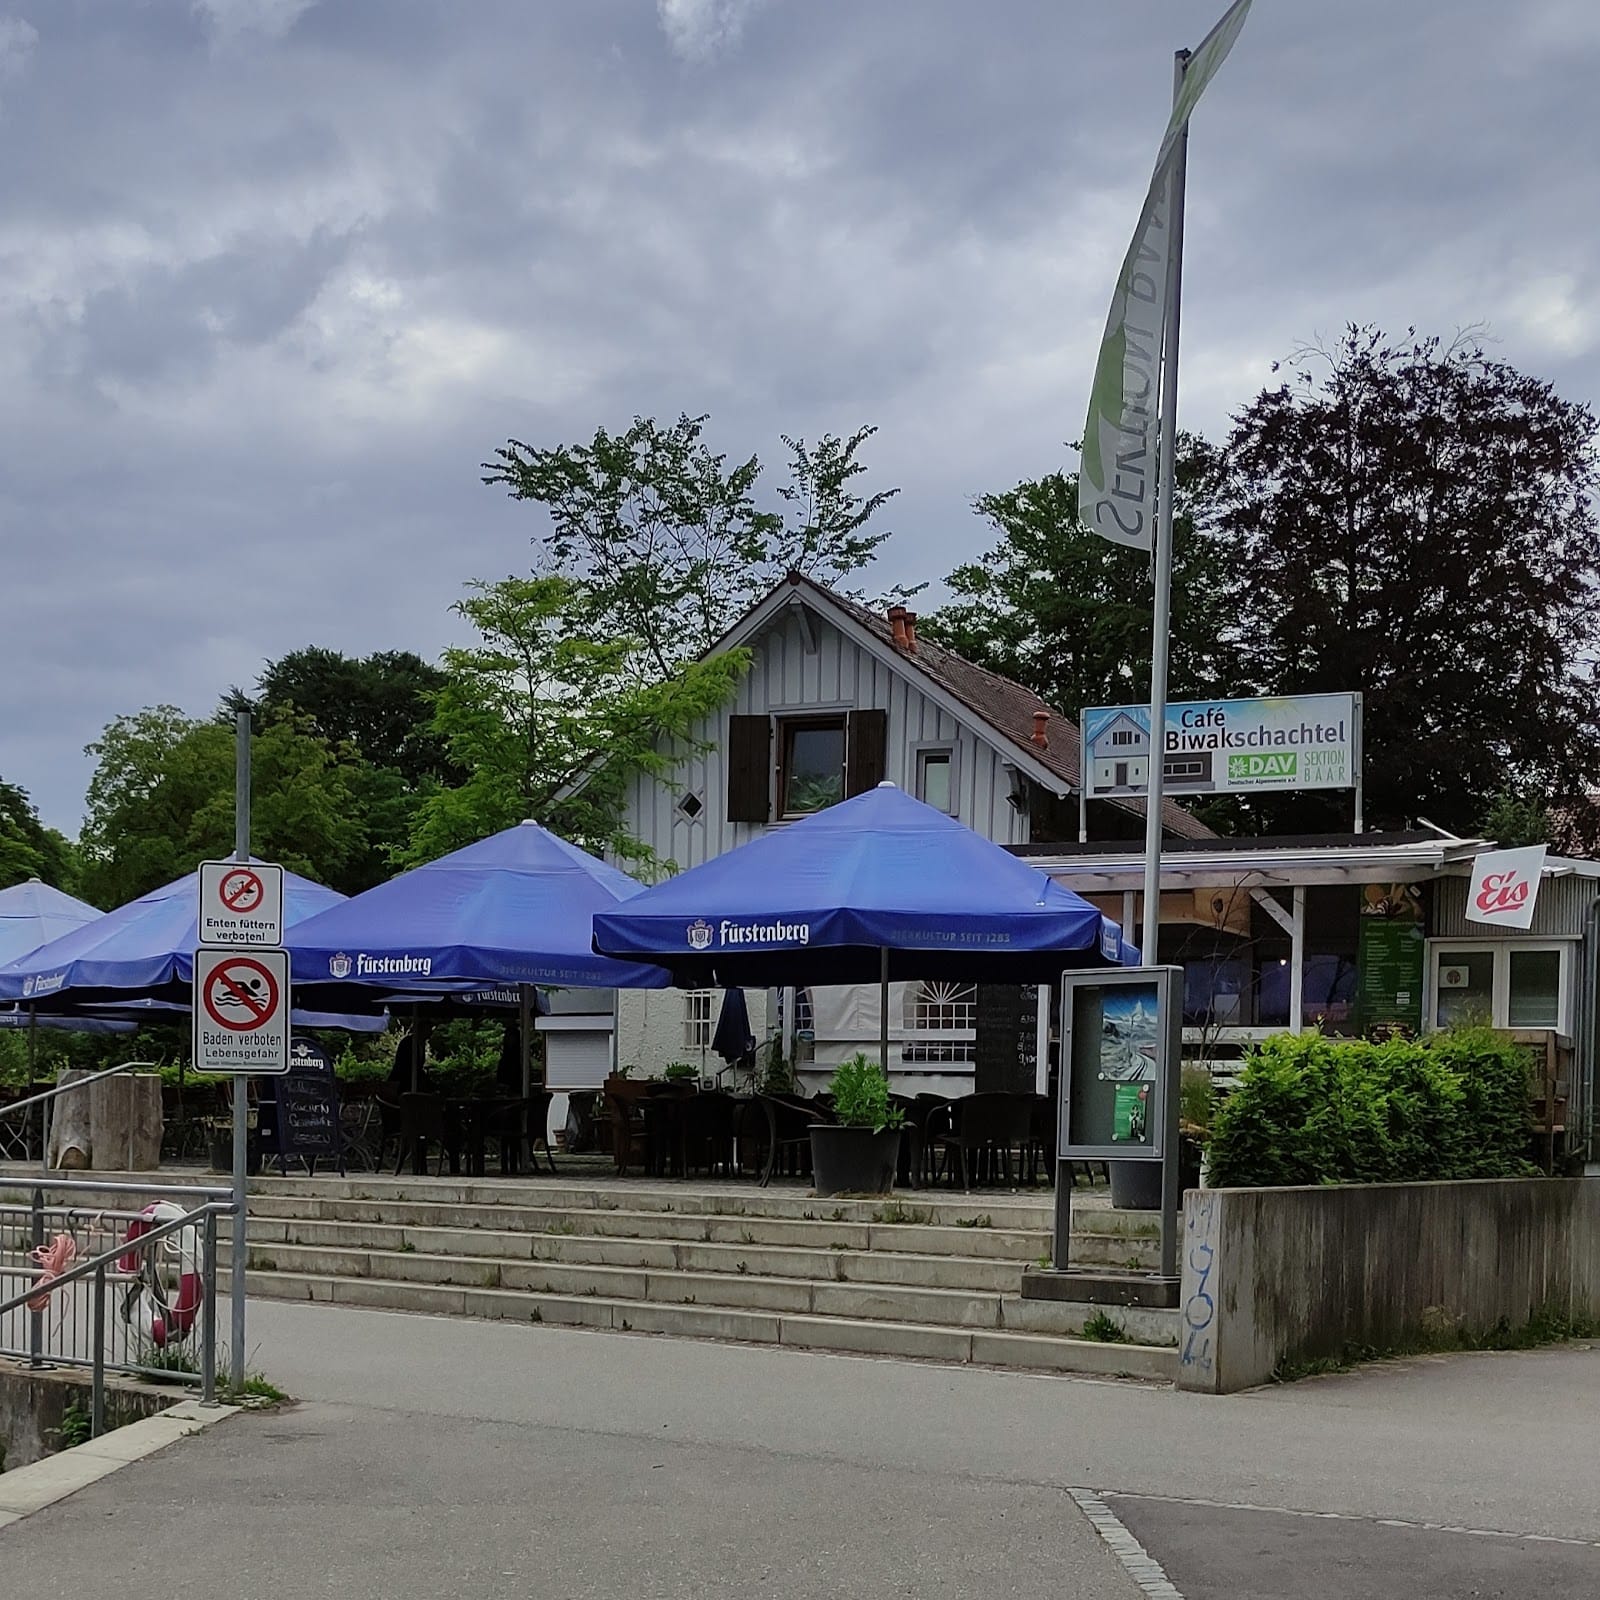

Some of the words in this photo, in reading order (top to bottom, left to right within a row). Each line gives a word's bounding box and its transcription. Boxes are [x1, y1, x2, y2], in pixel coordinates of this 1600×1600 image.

[1181, 706, 1226, 729] Café
[1165, 719, 1346, 751] Biwakschachtel
[1249, 754, 1295, 775] DAV
[1304, 750, 1345, 766] SEKTION
[1304, 766, 1345, 783] BAAR
[1476, 869, 1529, 912] Eis
[206, 917, 237, 930] Enten
[239, 918, 276, 931] füttern
[719, 919, 810, 946] Fürstenberg
[216, 930, 265, 942] verboten!
[959, 932, 982, 943] SEIT
[356, 953, 432, 977] Fürstenberg
[203, 1031, 233, 1046] Baden
[238, 1032, 282, 1047] verboten
[205, 1048, 279, 1060] Lebensgefahr
